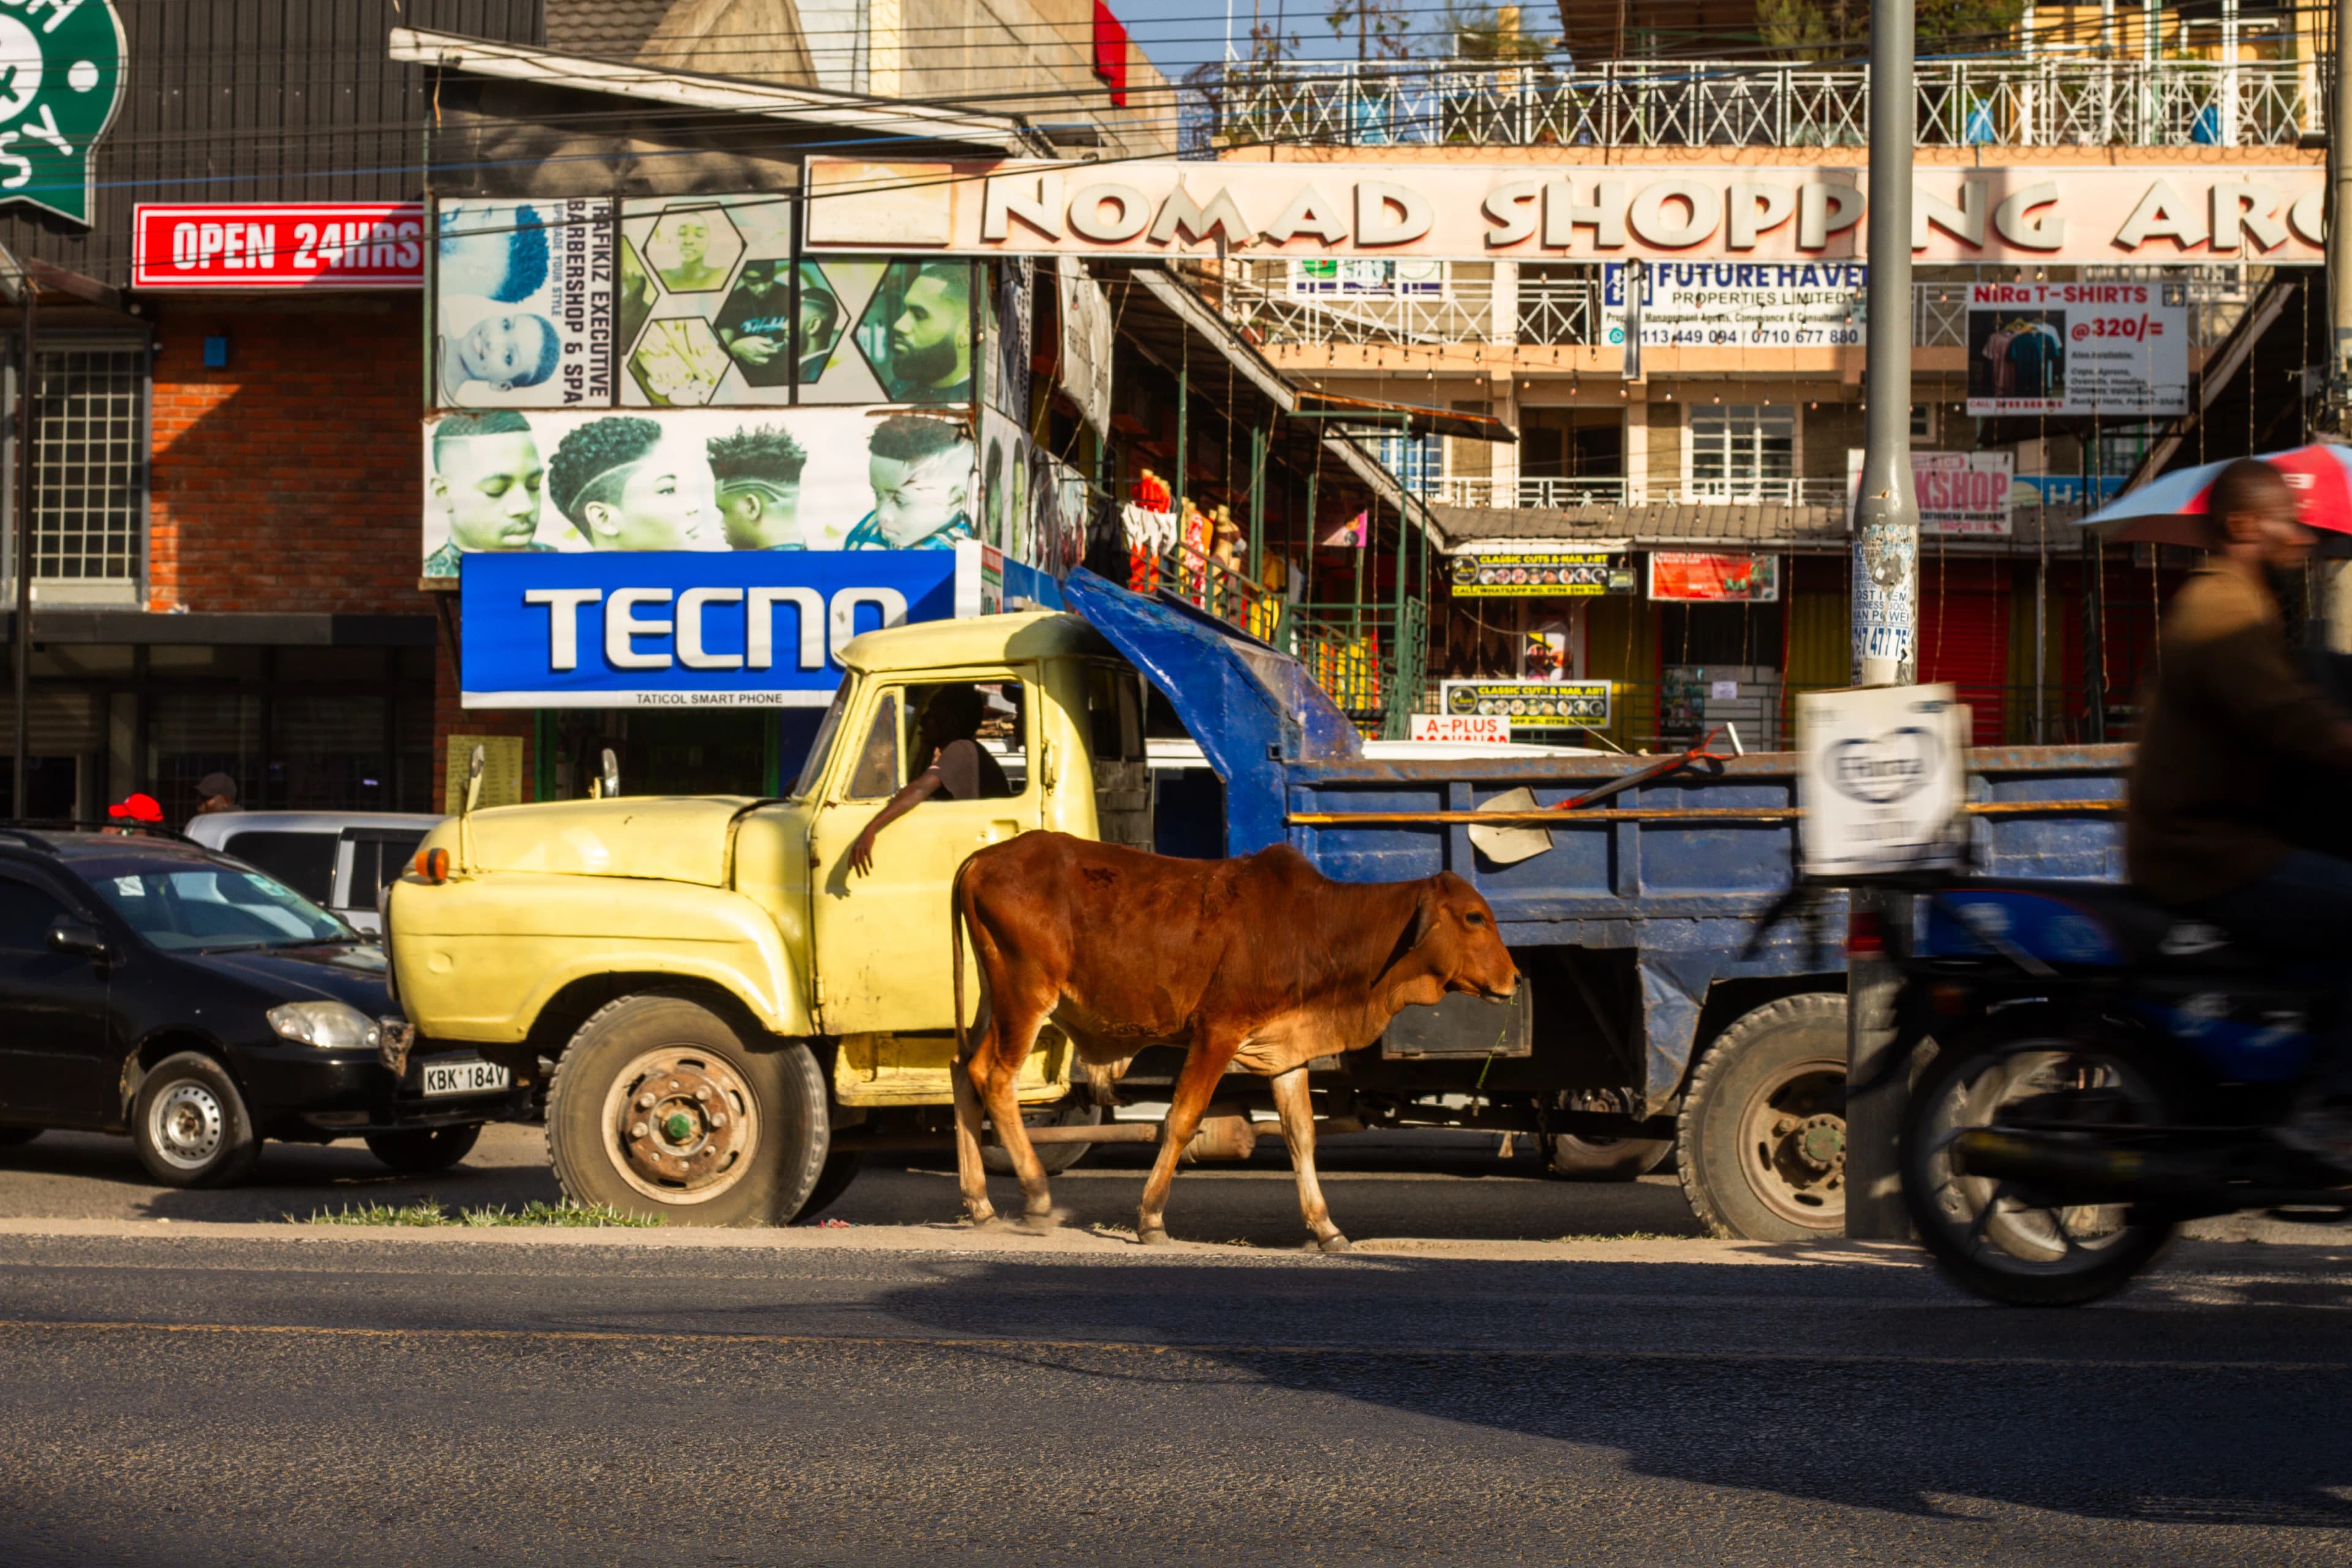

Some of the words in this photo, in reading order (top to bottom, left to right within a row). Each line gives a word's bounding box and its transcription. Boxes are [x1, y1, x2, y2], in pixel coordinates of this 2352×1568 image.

[984, 176, 1435, 249] NOMAD
[1480, 179, 2065, 251] SHOPPNG
[173, 223, 275, 270] OPEN
[293, 221, 420, 269] 24HRS
[552, 255, 562, 282] YOUR
[564, 200, 585, 333] BARBERSHOP
[1659, 264, 1770, 287] FUTURE
[1777, 264, 1868, 287] HAVE
[551, 286, 562, 316] STYLE
[1673, 292, 1776, 304] PROPERTIES
[1783, 292, 1847, 304] LIMITED
[1974, 285, 2030, 303] NiRa
[2035, 285, 2147, 303] T-SHIRTS
[1641, 330, 1669, 343] 113
[1676, 330, 1703, 343] 449
[1752, 330, 1789, 343] 0710
[1796, 330, 1823, 343] 677
[1830, 330, 1858, 343] 880
[2071, 313, 2163, 342] @320/=
[590, 292, 609, 397] EXECUTIVE
[564, 364, 582, 404] SPA
[1916, 471, 2007, 511] KSHOP
[1479, 554, 1521, 564] CLASSIC
[1523, 554, 1550, 564] CUTS
[1561, 554, 1584, 563] NAIL
[1586, 554, 1608, 563] ART
[525, 587, 908, 670] TECNO
[636, 693, 687, 704] TATICOL
[691, 693, 734, 704] SMART
[739, 693, 783, 704] PHONE
[1478, 686, 1520, 695] CLASSIC
[1559, 686, 1582, 695] NAIL
[1585, 686, 1605, 695] ART
[1427, 718, 1497, 733] A-PLUS
[428, 1068, 458, 1091] KBK
[468, 1065, 505, 1088] 184V
